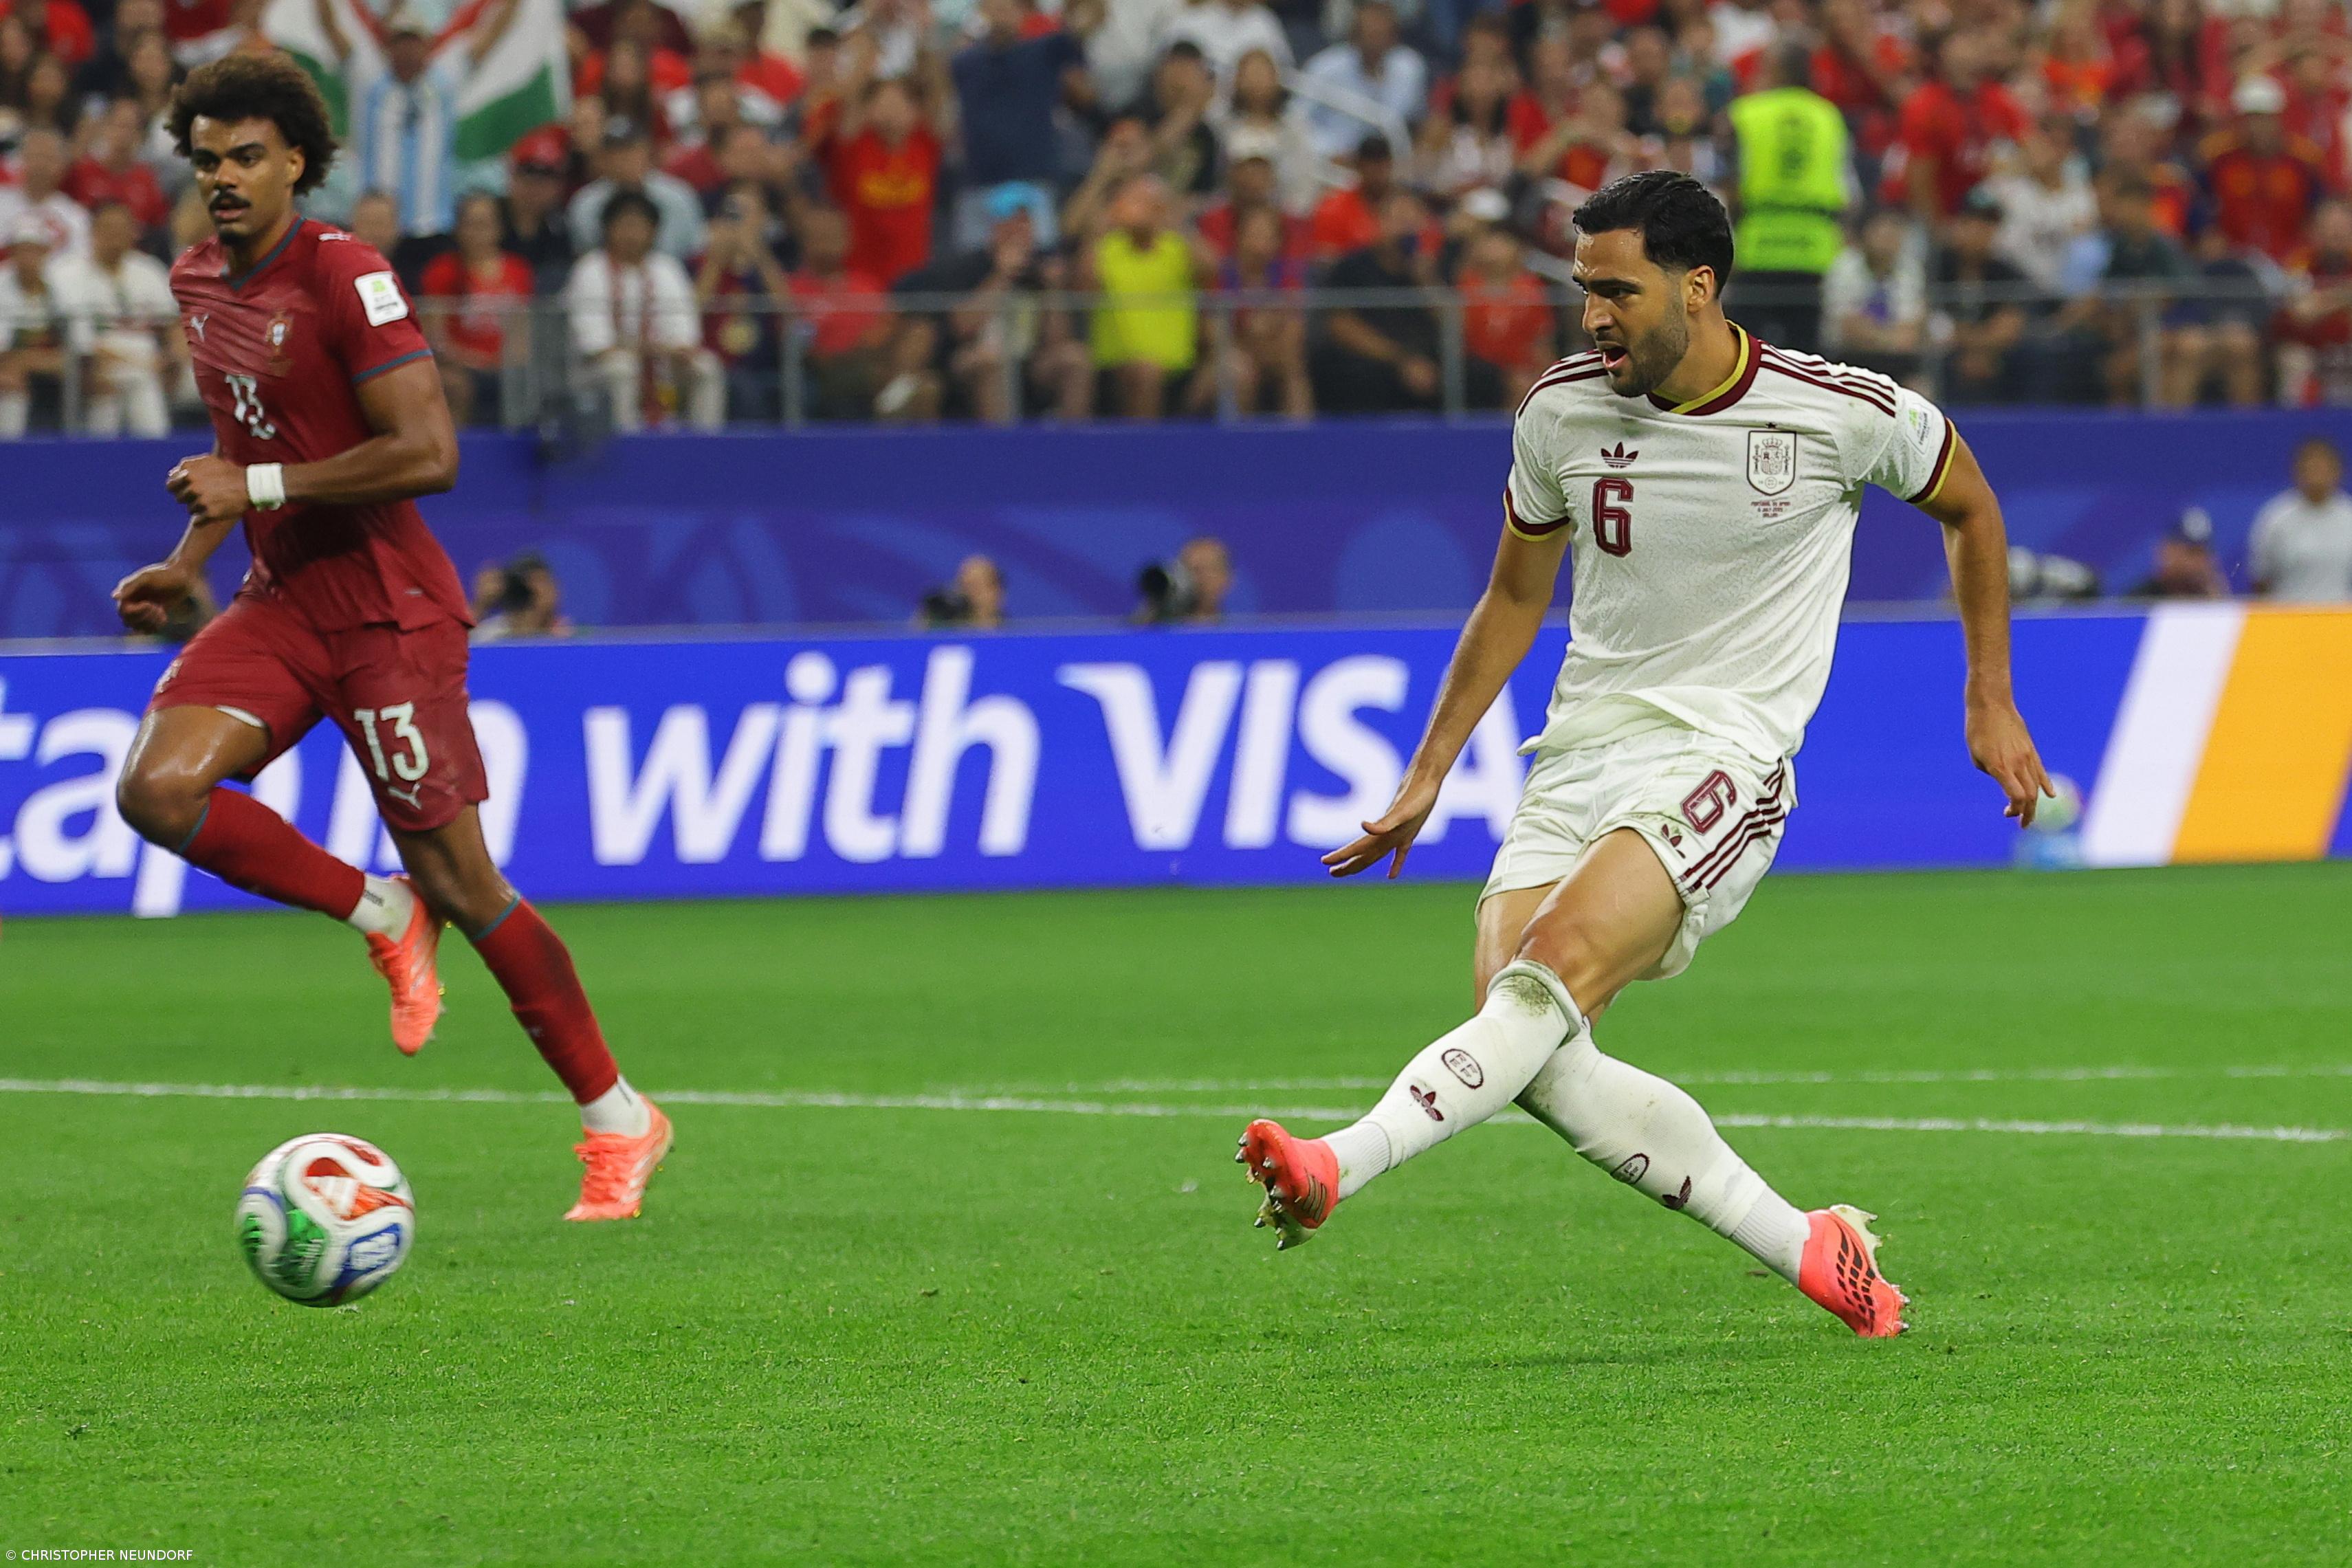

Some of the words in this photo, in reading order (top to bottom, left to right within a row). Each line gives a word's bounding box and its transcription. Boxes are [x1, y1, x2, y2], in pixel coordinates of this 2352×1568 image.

[1592, 476, 1634, 557] 6
[353, 700, 429, 782] 13
[582, 644, 1041, 866] with
[1054, 653, 1528, 851] VISA
[1680, 769, 1737, 836] 6
